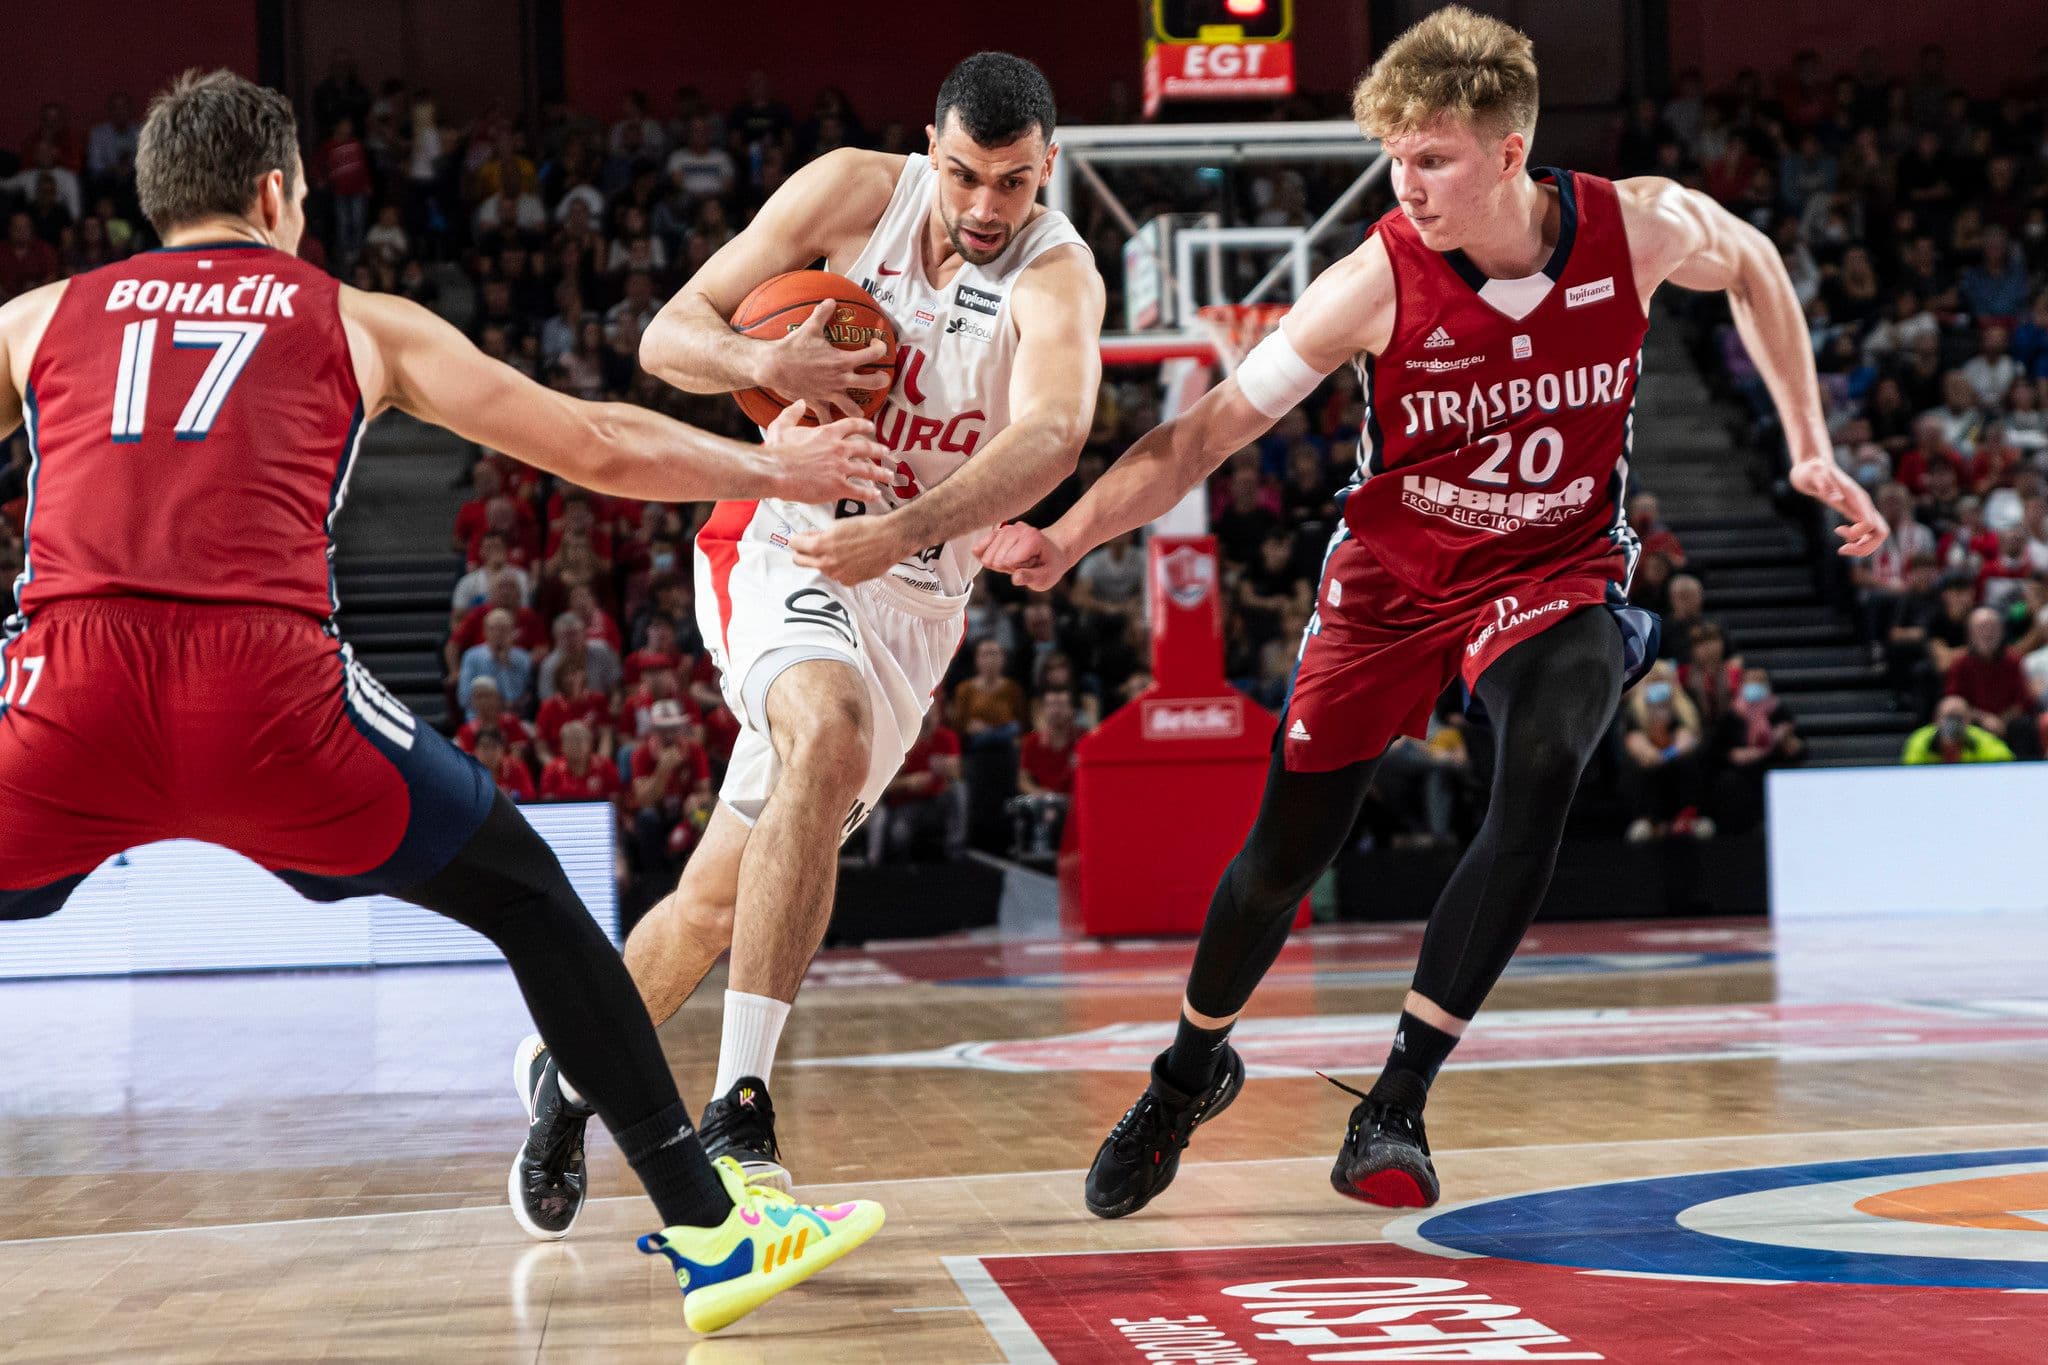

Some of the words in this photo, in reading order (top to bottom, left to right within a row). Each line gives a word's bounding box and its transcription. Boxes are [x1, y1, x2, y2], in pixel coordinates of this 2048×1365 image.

[1183, 43, 1267, 77] EGT
[105, 274, 300, 318] BOHAČÍK
[1569, 284, 1611, 302] bpifrance
[111, 318, 266, 443] 17
[1405, 355, 1486, 370] Strasbourg.eu
[1467, 427, 1564, 485] 20
[1402, 491, 1447, 515] FROID
[5, 655, 46, 707] 17
